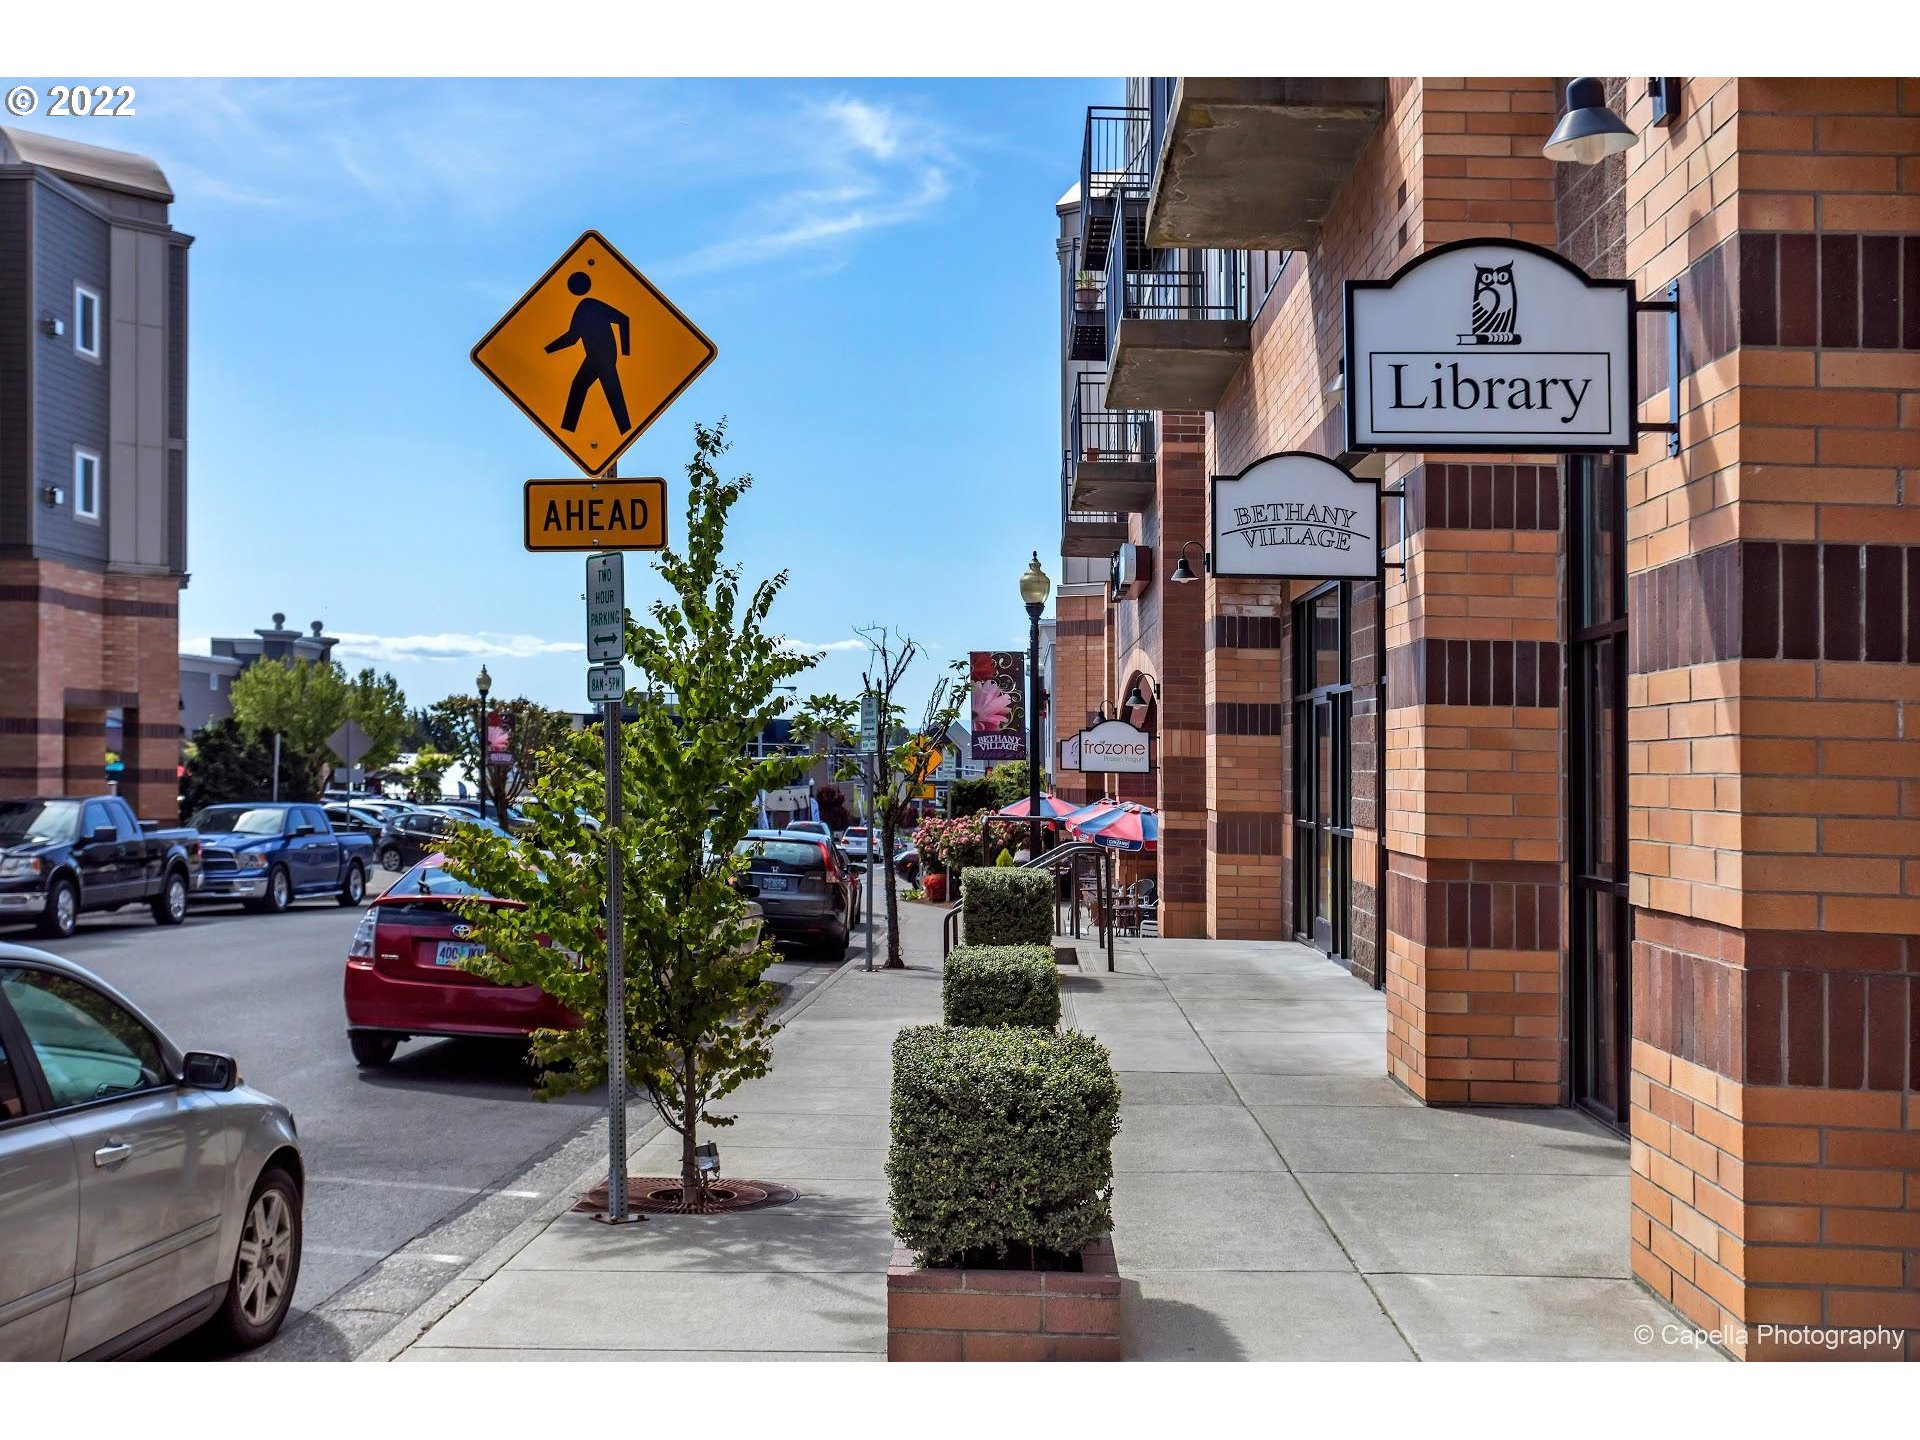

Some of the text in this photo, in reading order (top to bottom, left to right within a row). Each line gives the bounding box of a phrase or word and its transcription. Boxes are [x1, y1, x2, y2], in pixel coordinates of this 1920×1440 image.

[1388, 362, 1592, 424] Library
[543, 498, 648, 532] AHEAD
[1234, 502, 1358, 528] BETHANY
[1240, 527, 1351, 551] VILLAGE
[597, 568, 612, 583] TWO
[595, 589, 615, 604] HOUR
[590, 610, 620, 627] PARKING
[977, 734, 1021, 744] BETHANY
[979, 742, 1018, 751] VILLAGE
[1083, 739, 1146, 755] frozone
